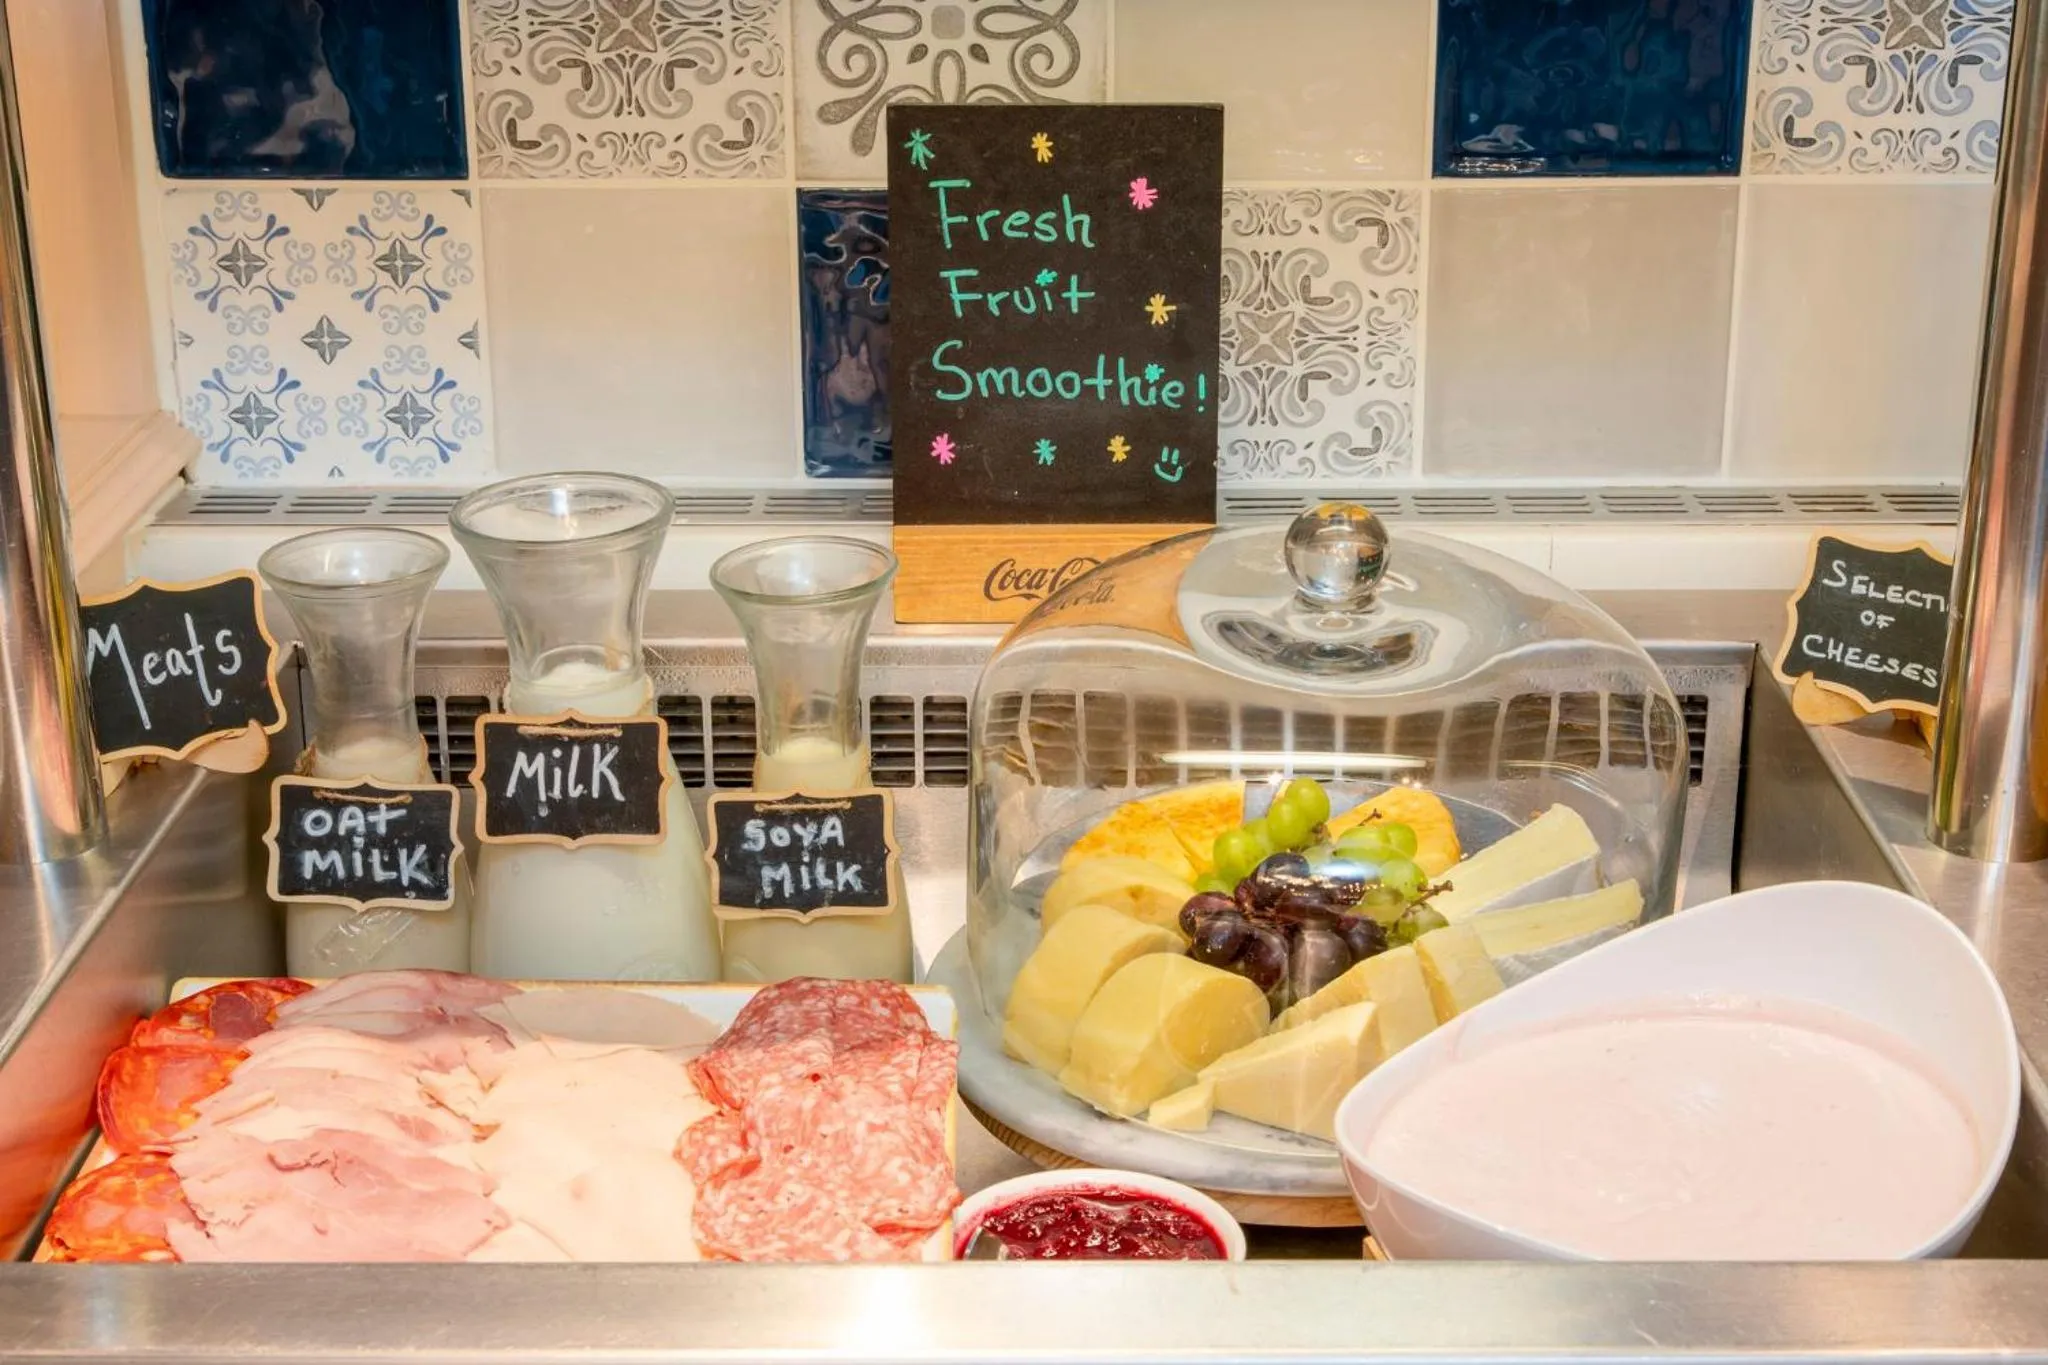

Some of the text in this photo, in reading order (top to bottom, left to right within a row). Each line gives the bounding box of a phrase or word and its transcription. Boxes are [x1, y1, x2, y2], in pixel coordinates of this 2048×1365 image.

[929, 179, 1095, 248] Fresh
[940, 268, 1096, 318] Fruit
[932, 340, 1206, 413] Smoothie!
[1822, 559, 1949, 612] SELECTI
[1860, 609, 1896, 629] OF
[87, 612, 243, 730] Meats
[1802, 634, 1938, 689] CHEESES
